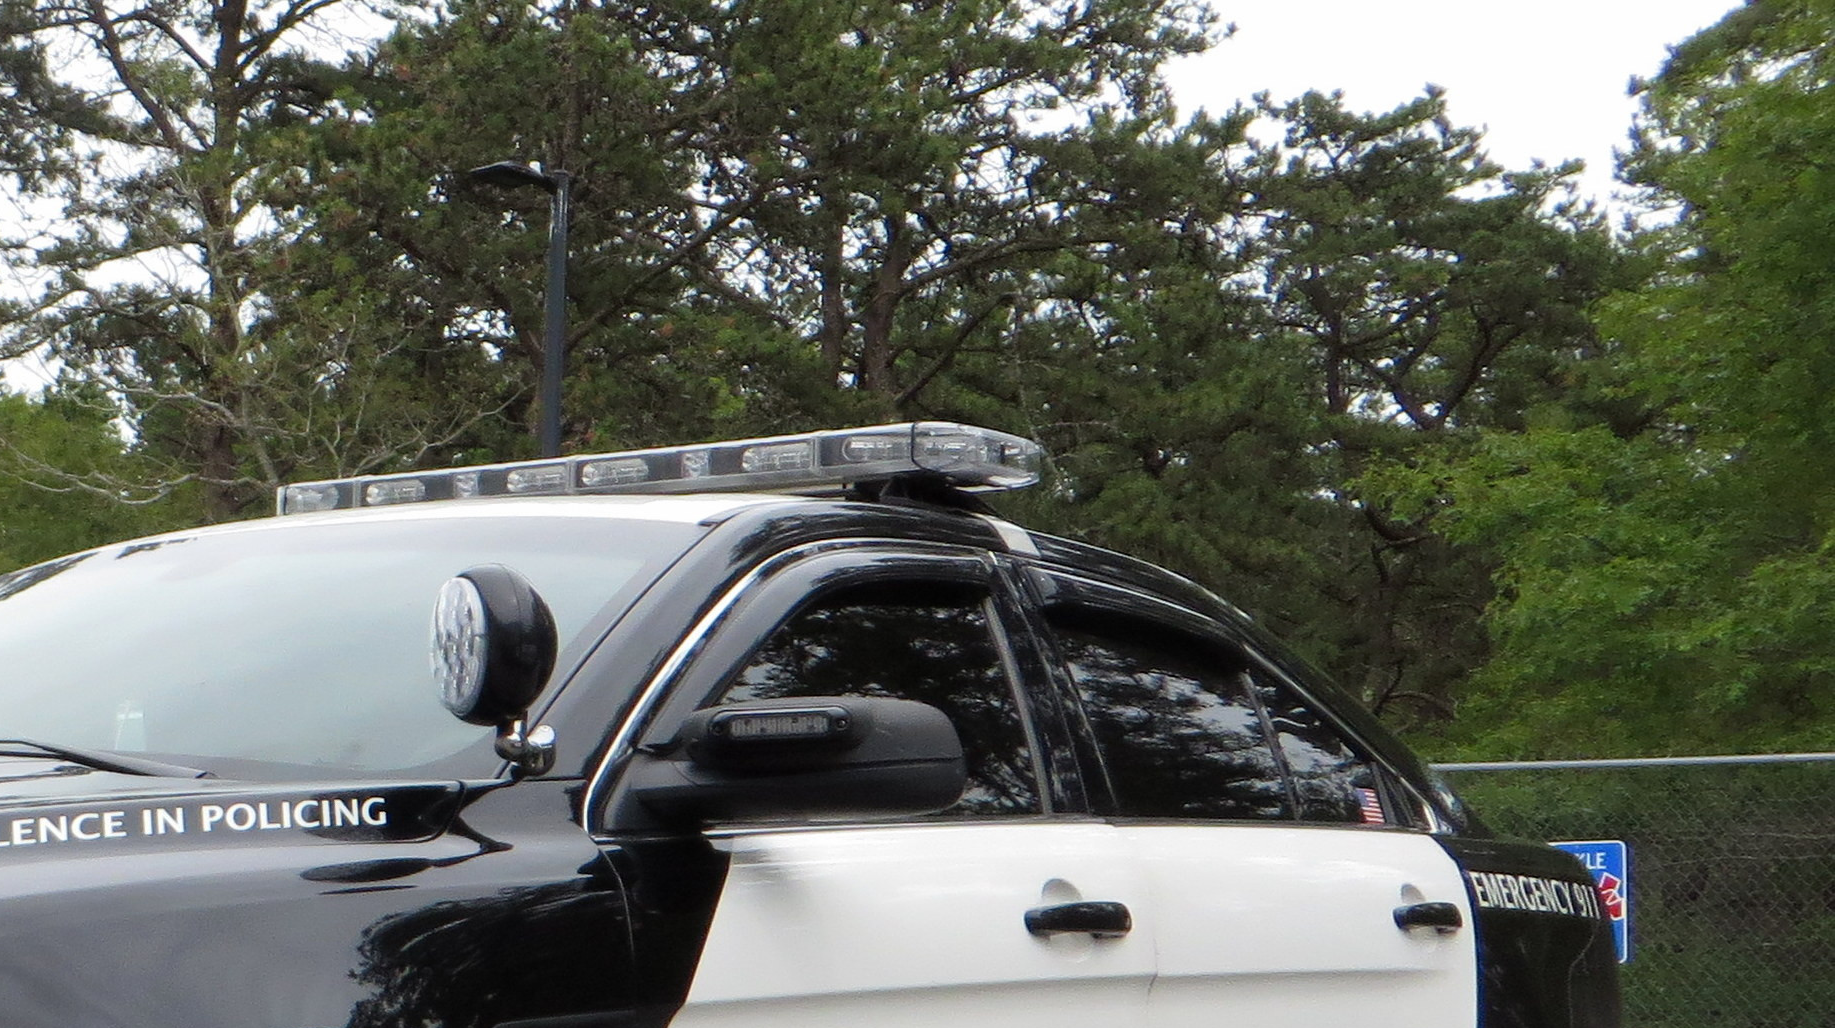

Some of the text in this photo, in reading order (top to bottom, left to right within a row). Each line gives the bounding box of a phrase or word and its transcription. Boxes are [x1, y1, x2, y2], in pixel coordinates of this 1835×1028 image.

[142, 807, 185, 836] IN
[201, 797, 389, 831] POLICING
[1468, 871, 1601, 920] EMERGENCY 911
